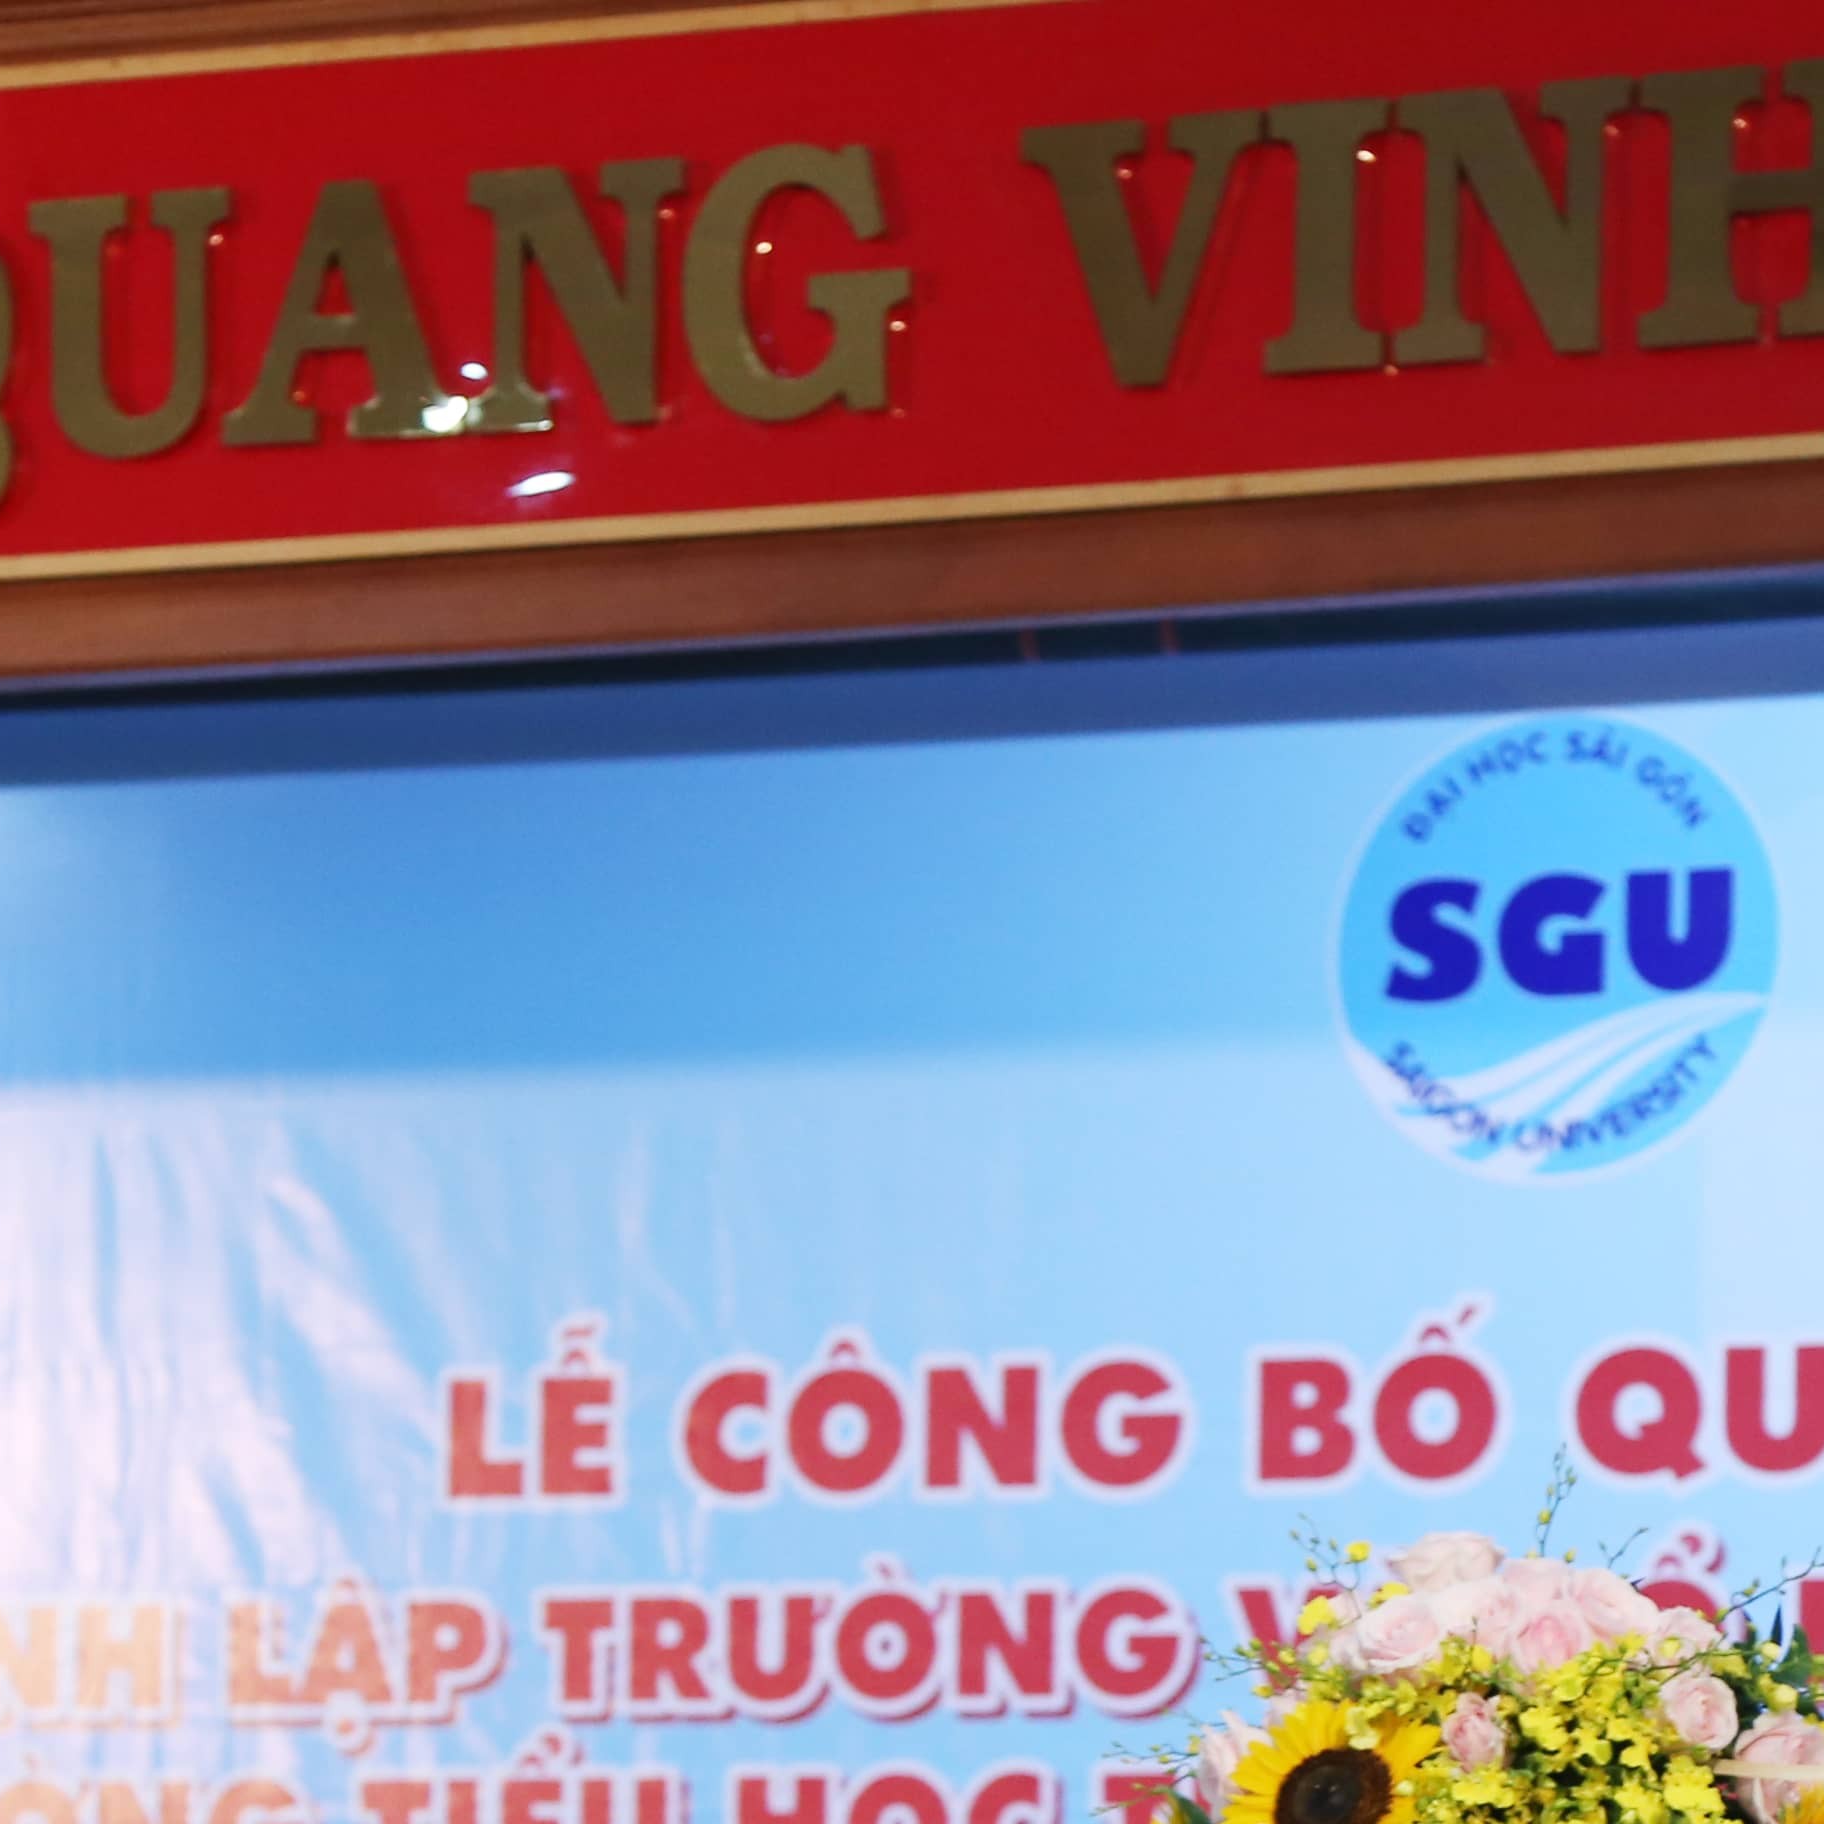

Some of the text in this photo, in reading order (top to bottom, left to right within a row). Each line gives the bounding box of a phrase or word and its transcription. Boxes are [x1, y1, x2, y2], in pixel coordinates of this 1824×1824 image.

[1384, 866, 1734, 1007] SGU
[447, 1323, 616, 1500] LỄ
[683, 1336, 1183, 1496] CÔNG
[1257, 1300, 1499, 1483] BỐ
[226, 1578, 493, 1740] LẬP
[542, 1559, 1179, 1704] TRƯỜNG
